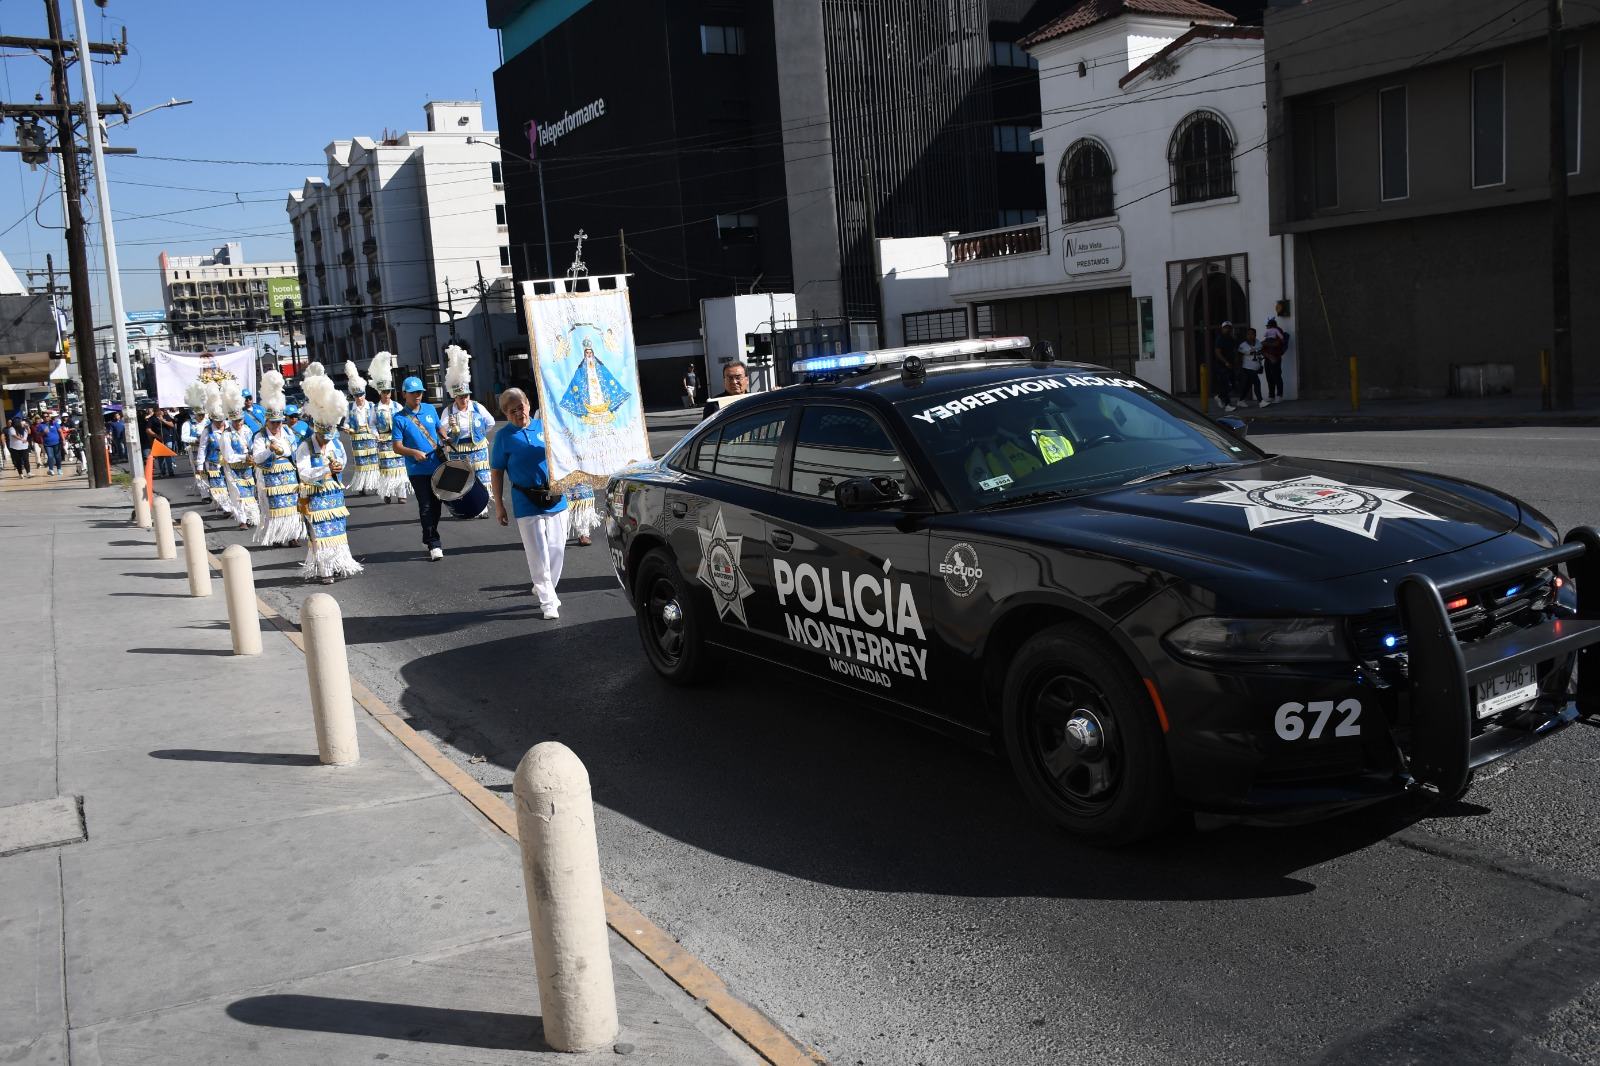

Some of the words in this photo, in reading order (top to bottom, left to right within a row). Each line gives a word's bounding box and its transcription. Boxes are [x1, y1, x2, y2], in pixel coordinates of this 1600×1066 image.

[537, 97, 605, 147] Teleperformance
[1088, 241, 1102, 249] Vista
[1076, 257, 1110, 268] PRESTAMOS
[272, 284, 293, 293] hotel
[939, 563, 983, 579] ESCUDO
[772, 557, 927, 641] POLICÍA
[784, 612, 928, 681] MONTERREY
[828, 656, 892, 688] MOVILIDAD
[1274, 698, 1362, 741] 672
